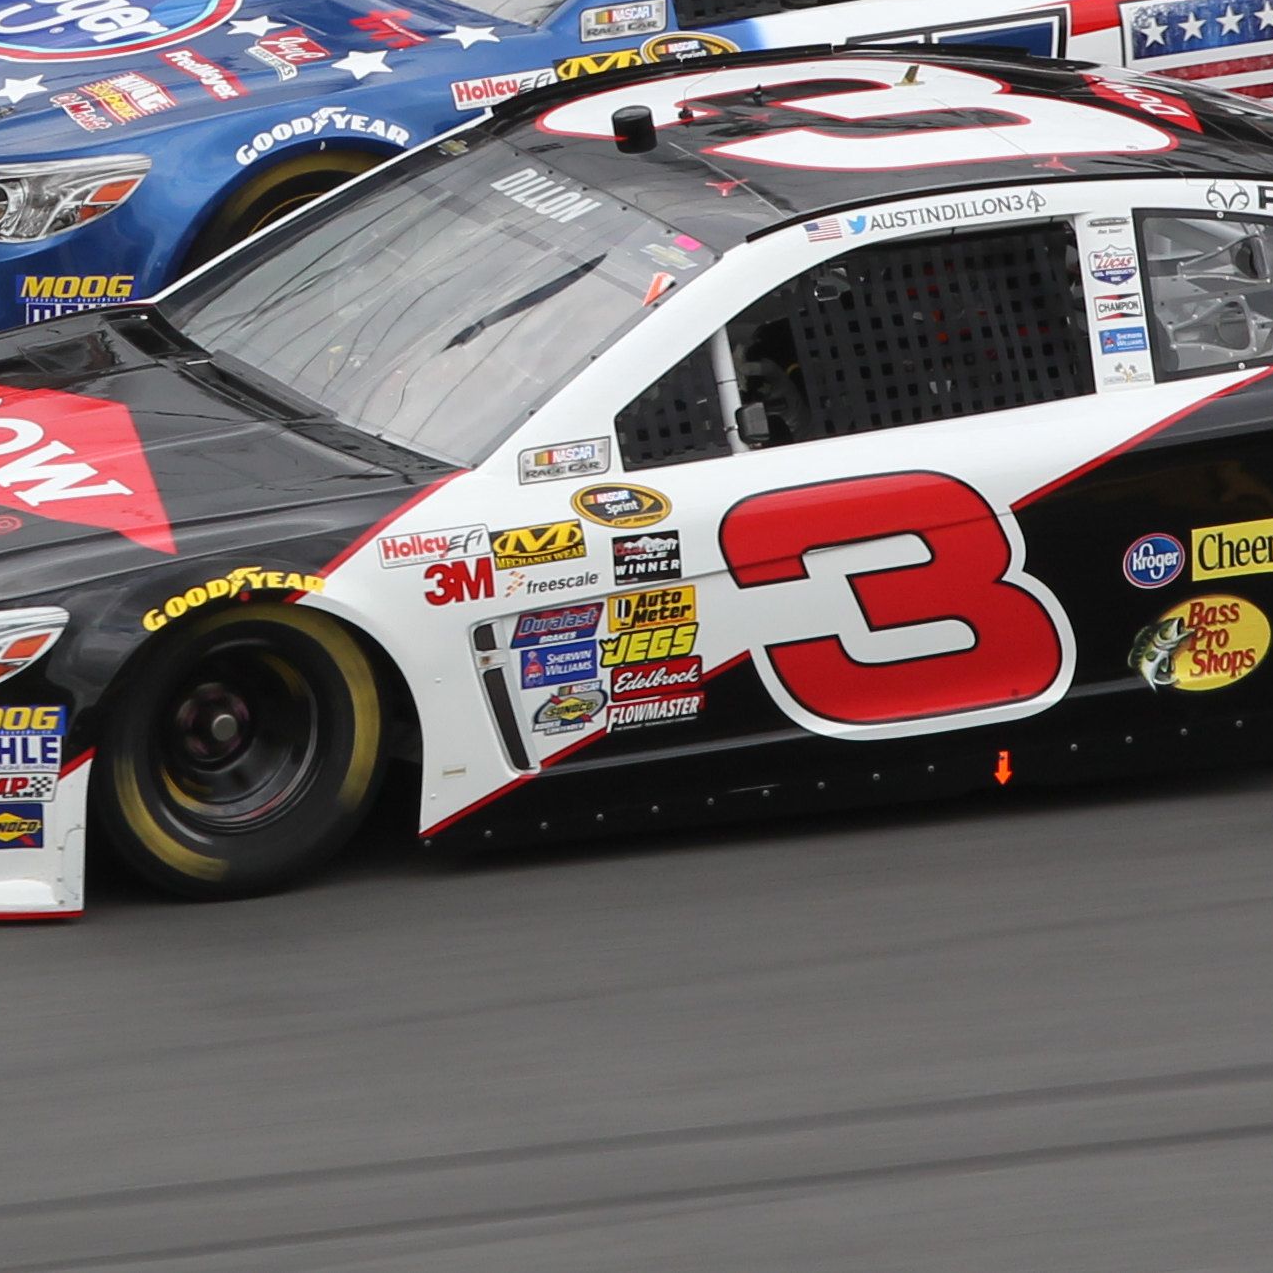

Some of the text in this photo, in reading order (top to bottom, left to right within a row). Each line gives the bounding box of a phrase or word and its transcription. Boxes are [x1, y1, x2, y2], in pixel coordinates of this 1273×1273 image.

[610, 4, 652, 24] NASCAR
[454, 76, 519, 104] Holley
[235, 105, 410, 166] GOODYEAR
[489, 167, 603, 224] DILLON
[869, 194, 1025, 232] AUSTINDILLON3
[20, 275, 135, 298] MOOG
[1098, 300, 1139, 313] CHAMPION
[552, 444, 594, 463] NASCAR
[604, 499, 640, 516] Sprint
[381, 527, 485, 559] Holley EFI
[495, 544, 586, 569] MECHANIX WEAR
[615, 559, 680, 576] WINNER
[1131, 542, 1180, 580] Kroger
[422, 557, 495, 607] 3M
[526, 571, 600, 595] freescale
[143, 564, 327, 633] GOODYEAR
[636, 589, 682, 609] Auto
[717, 468, 1073, 737] 3
[521, 607, 598, 634] Duralast
[631, 603, 692, 625] Meter
[1188, 601, 1241, 628] Bass
[538, 631, 577, 644] BRAKES
[601, 623, 699, 667] JEGS
[1188, 627, 1230, 651] Pro
[545, 648, 592, 665] SHERWIN
[1189, 647, 1257, 678] Shops
[613, 663, 700, 693] Edelbrock
[606, 695, 701, 733] FLOWMASTER
